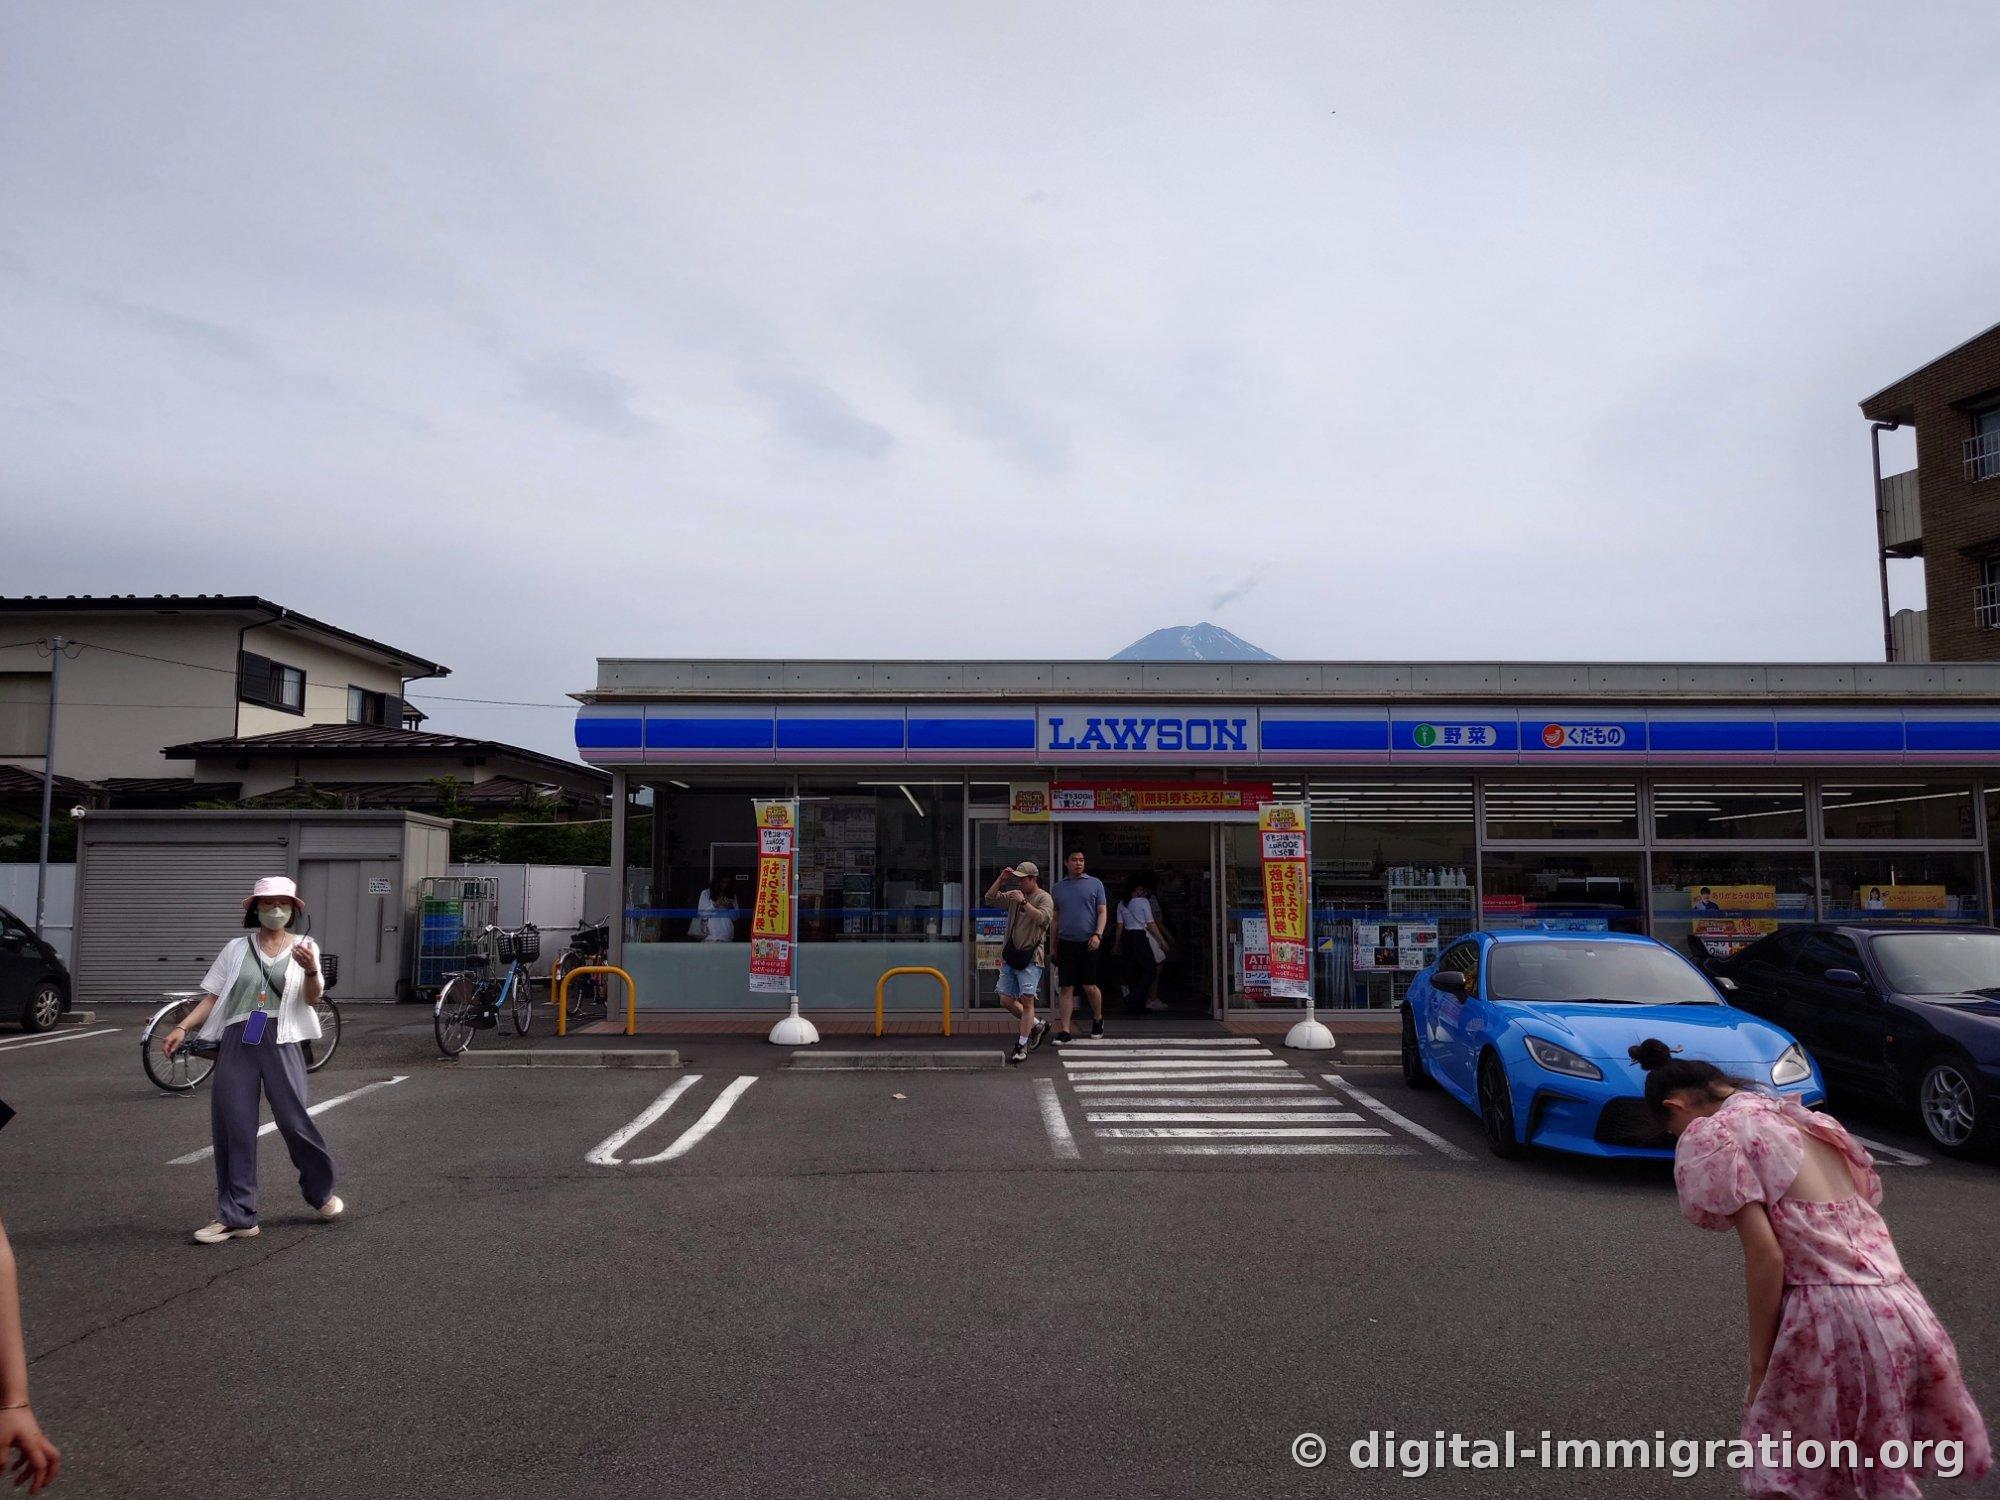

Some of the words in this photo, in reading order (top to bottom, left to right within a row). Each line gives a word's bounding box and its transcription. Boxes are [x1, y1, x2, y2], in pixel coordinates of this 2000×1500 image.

[1048, 718, 1247, 750] LAWSON
[1443, 727, 1486, 744] 野菜
[1568, 727, 1621, 744] くだもの
